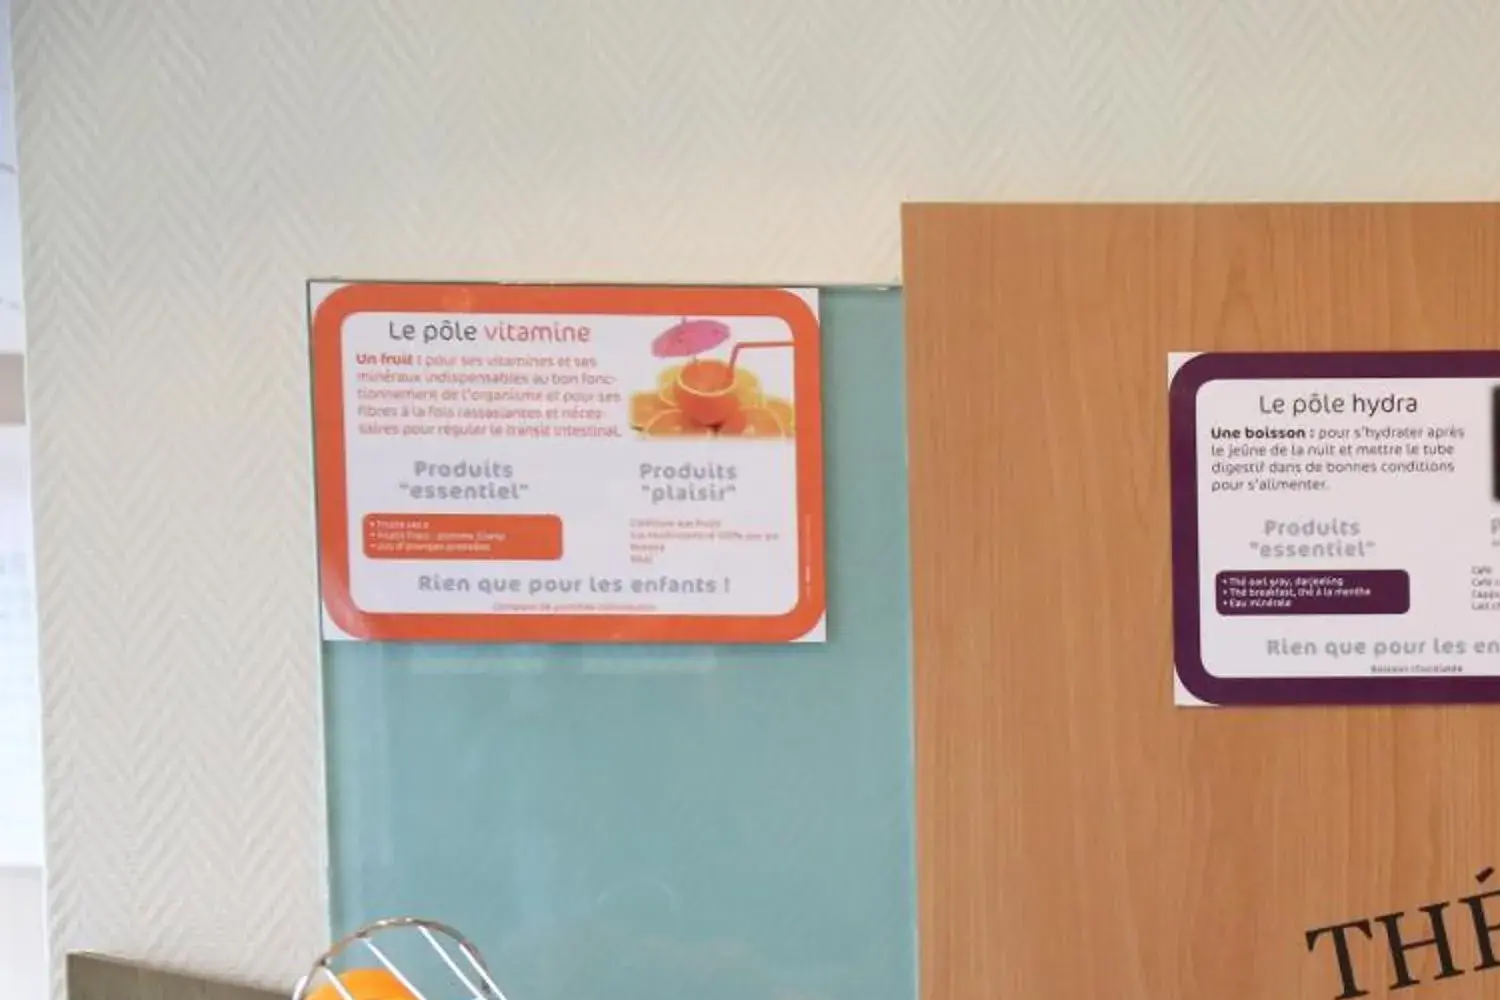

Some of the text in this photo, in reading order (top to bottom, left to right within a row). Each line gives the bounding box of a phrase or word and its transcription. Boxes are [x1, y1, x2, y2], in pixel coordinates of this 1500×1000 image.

[388, 320, 591, 344] Le pôle vitamine
[356, 353, 377, 365] Un
[381, 352, 413, 365] fruit
[1259, 393, 1418, 417] Le pôle hydra
[1211, 425, 1241, 439] Une
[1245, 425, 1306, 439] boisson
[1319, 428, 1350, 440] pour
[1353, 425, 1423, 441] s'hydrater
[1427, 424, 1465, 441] après
[1211, 442, 1455, 458] le jeûne de la nuit et mettre le tube
[413, 461, 514, 479] Produits
[639, 462, 738, 480] Produits
[1211, 460, 1455, 476] digestif dans de bonnes conditions
[1211, 480, 1244, 493] pour
[1264, 518, 1361, 536] Produits
[417, 574, 731, 596] Rien que pour les enfants !
[1266, 638, 1317, 656] Rien
[1325, 640, 1366, 658] que
[1374, 640, 1427, 657] pour
[1433, 637, 1466, 655] les
